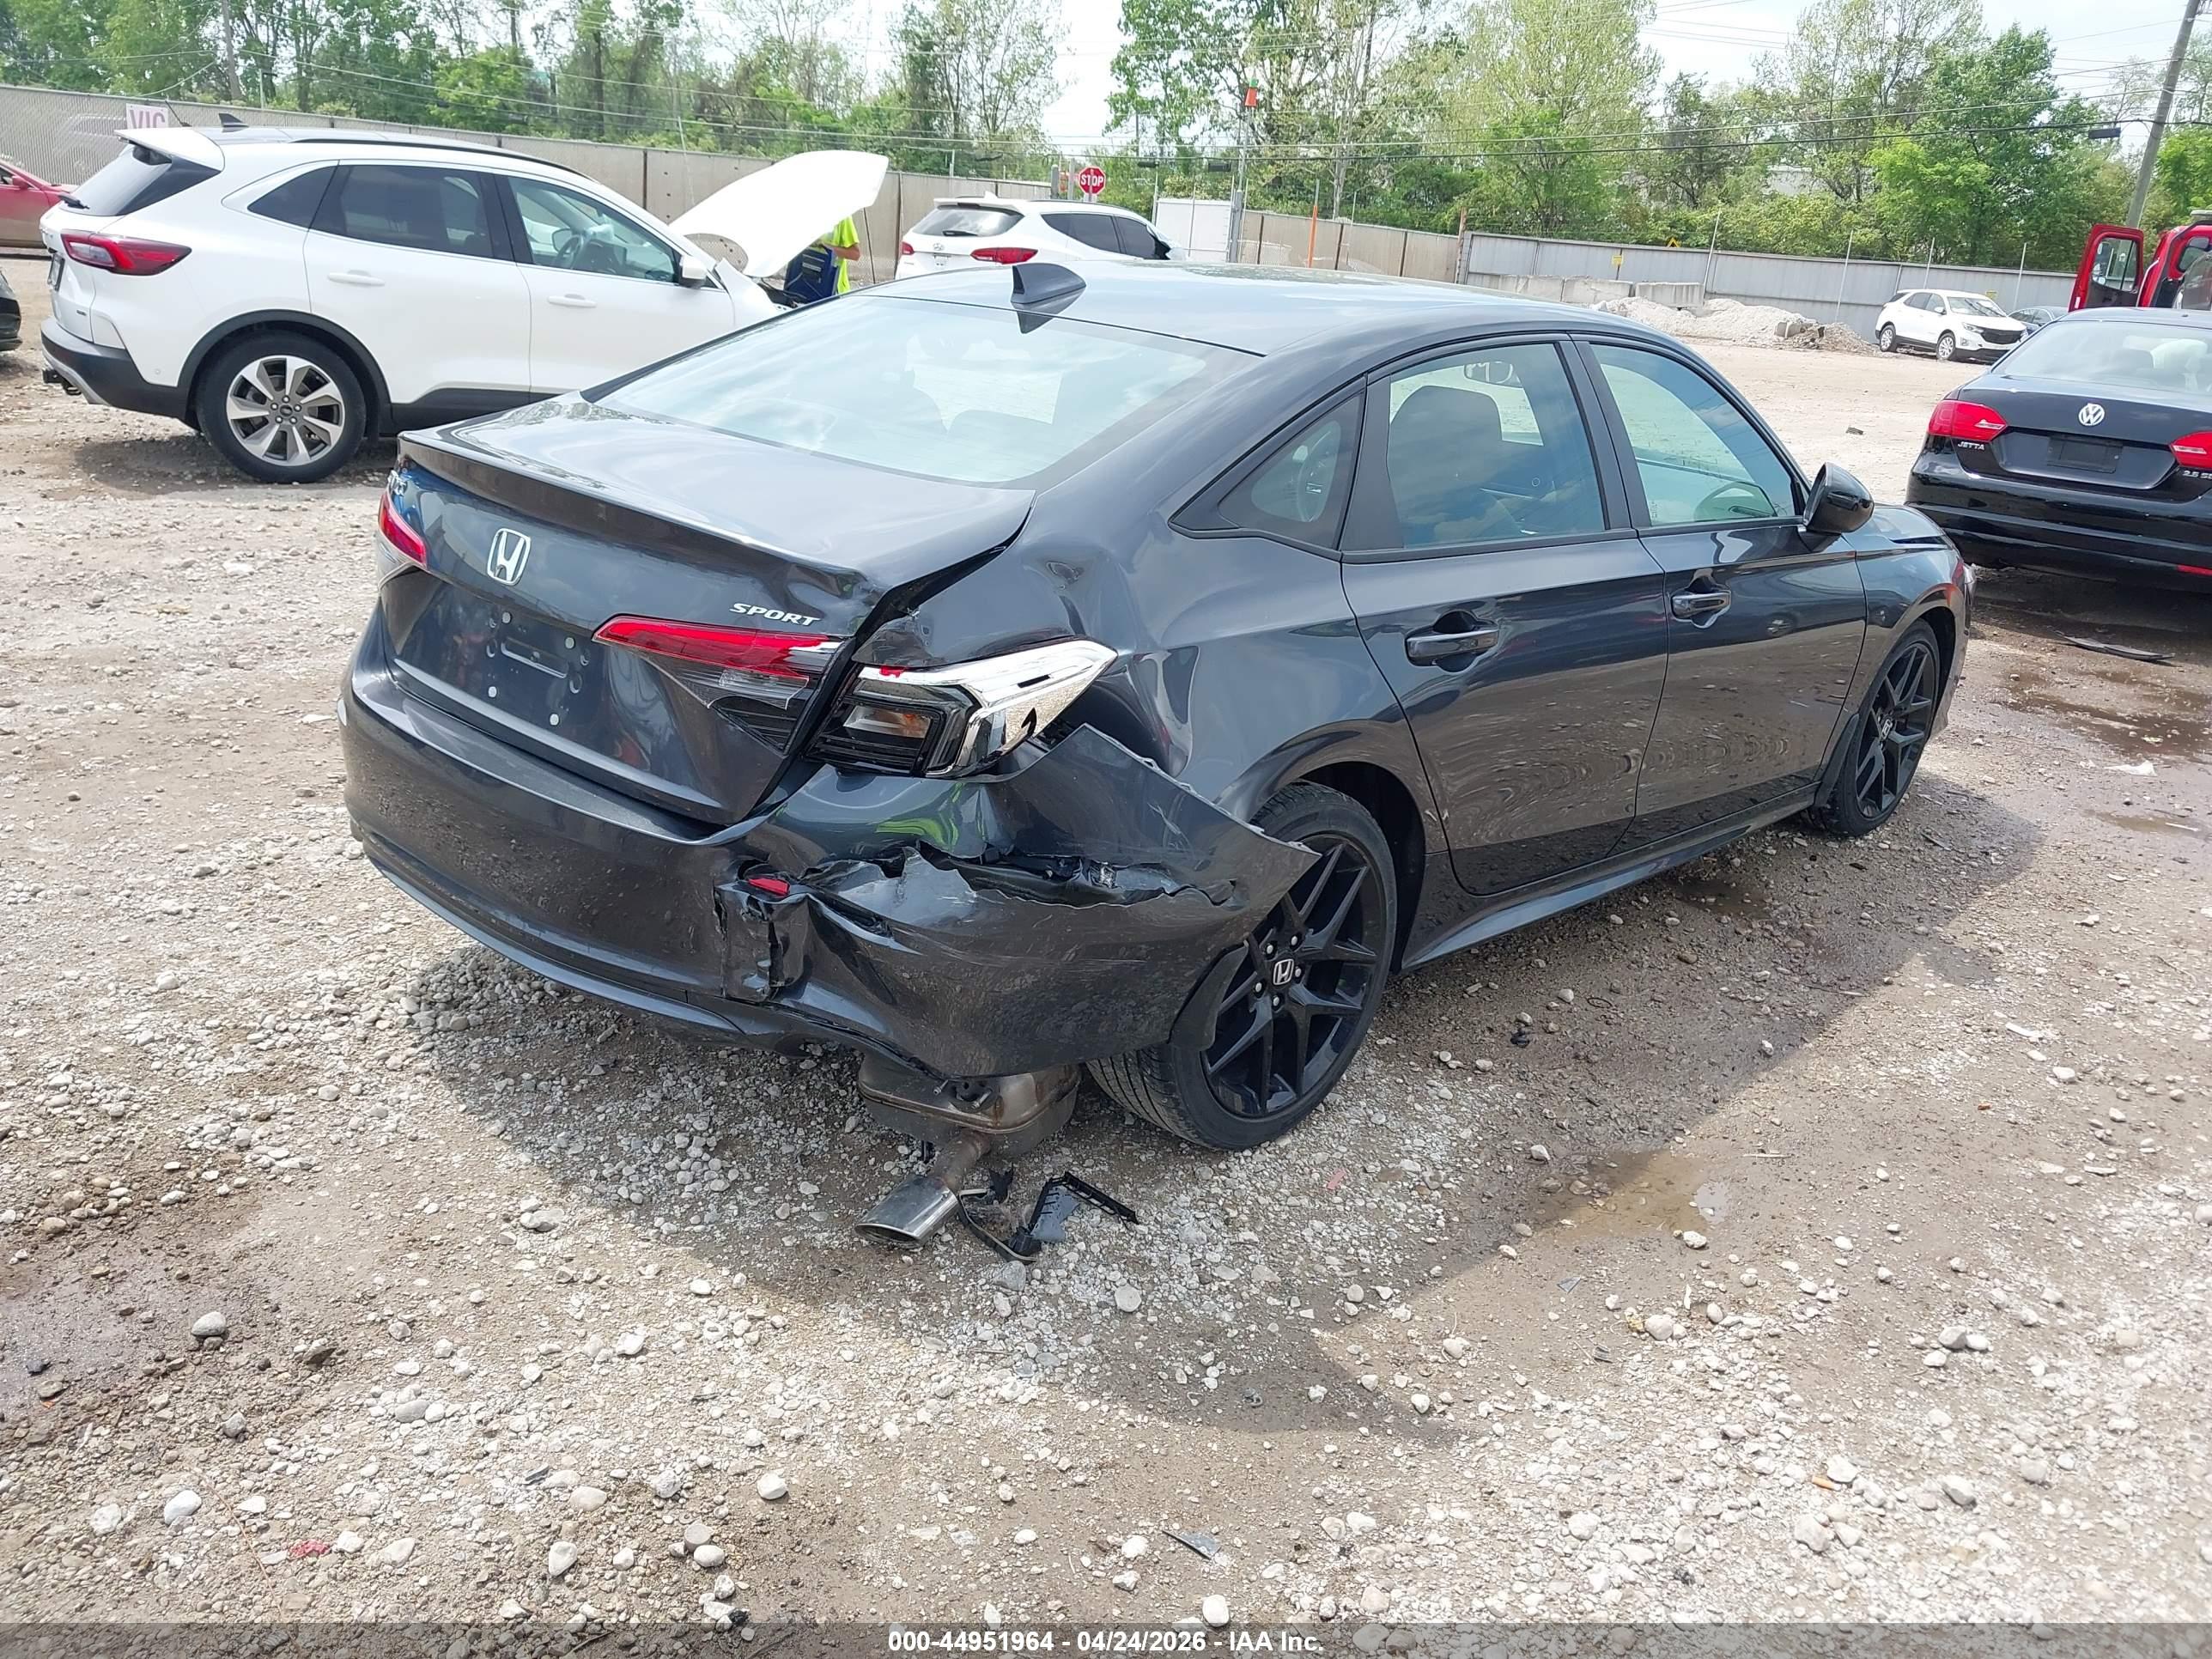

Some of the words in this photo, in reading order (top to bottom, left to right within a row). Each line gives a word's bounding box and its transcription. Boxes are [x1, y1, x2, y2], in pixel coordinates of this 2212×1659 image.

[1080, 174, 1104, 186] STOP
[1957, 441, 1985, 451] JETTA
[729, 603, 821, 626] SPORT
